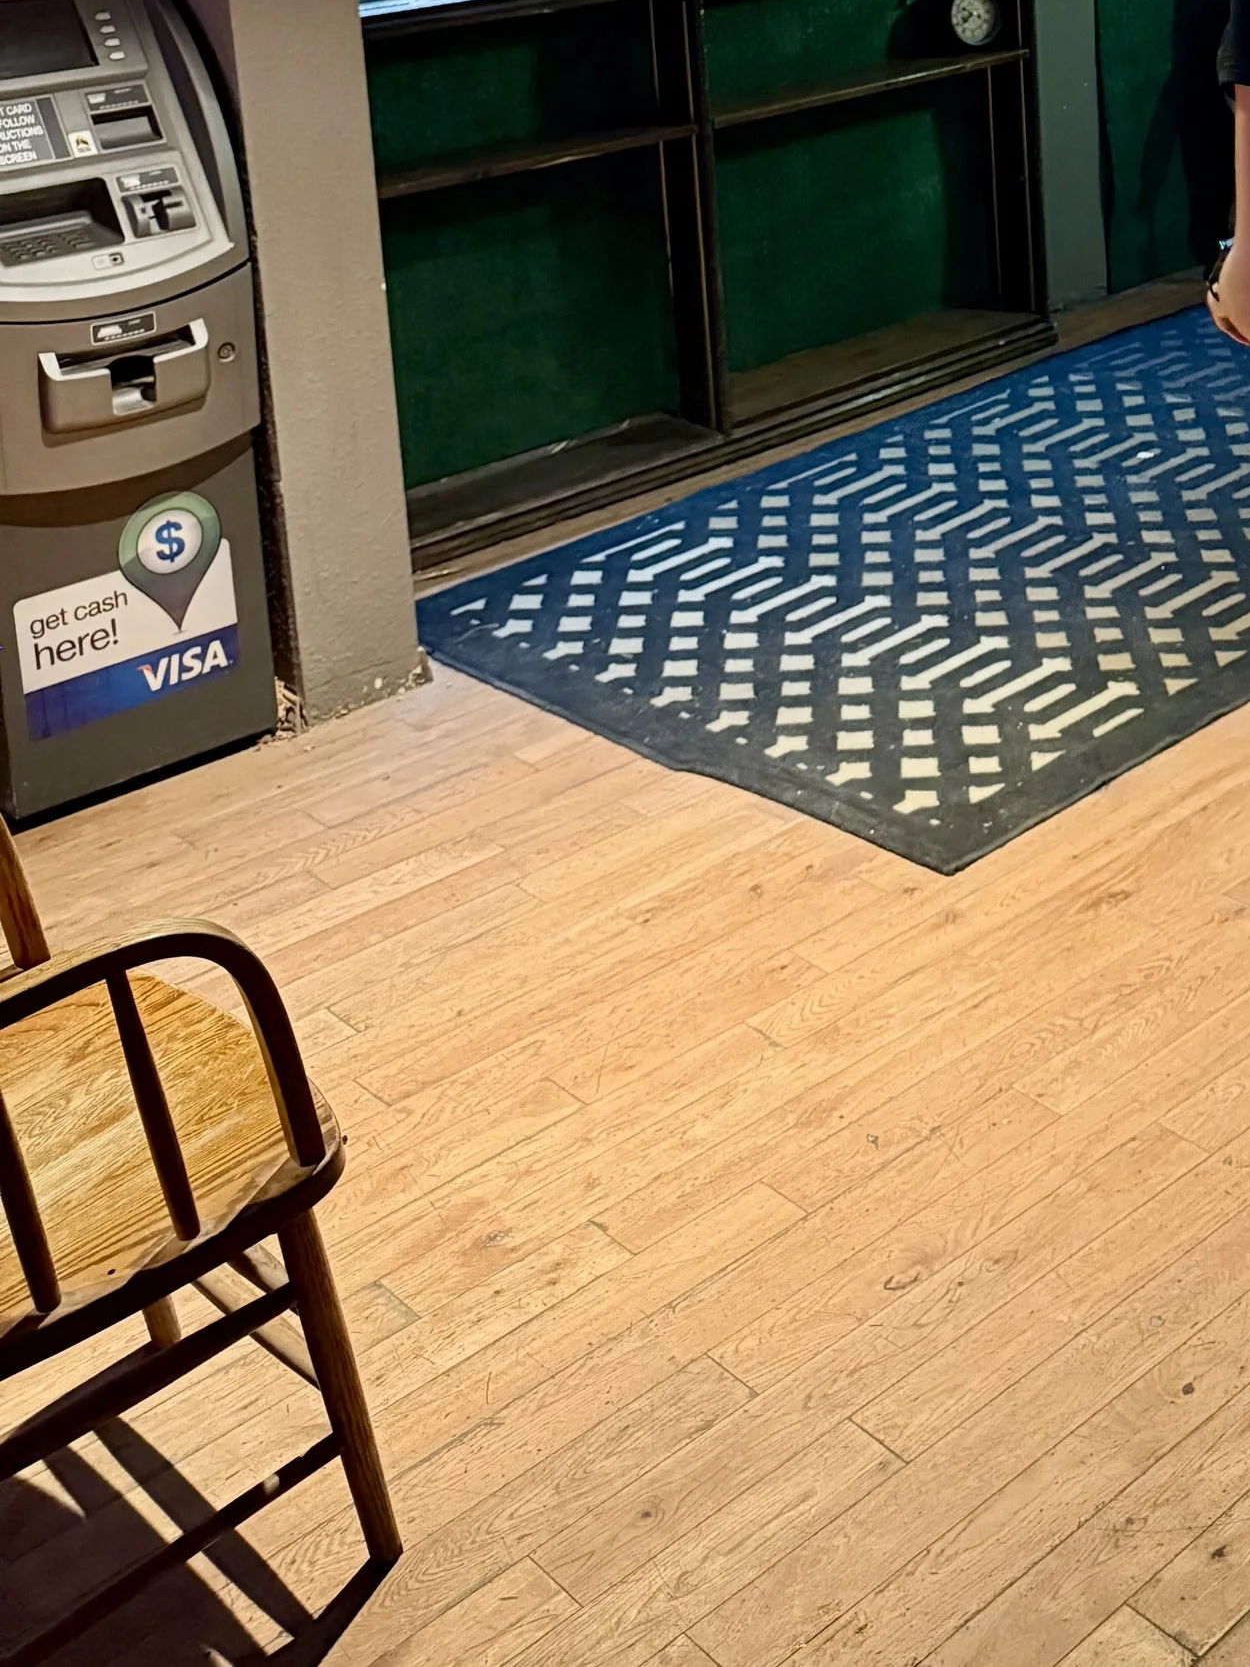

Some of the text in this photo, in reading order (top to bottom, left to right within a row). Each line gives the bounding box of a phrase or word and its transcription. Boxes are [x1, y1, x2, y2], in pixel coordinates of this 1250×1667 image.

[6, 103, 32, 116] CARD
[0, 125, 43, 141] UCTIONS
[11, 138, 32, 151] THE
[155, 520, 185, 562] $
[30, 591, 128, 639] get cash
[34, 618, 118, 670] here!
[138, 639, 229, 692] VISA
